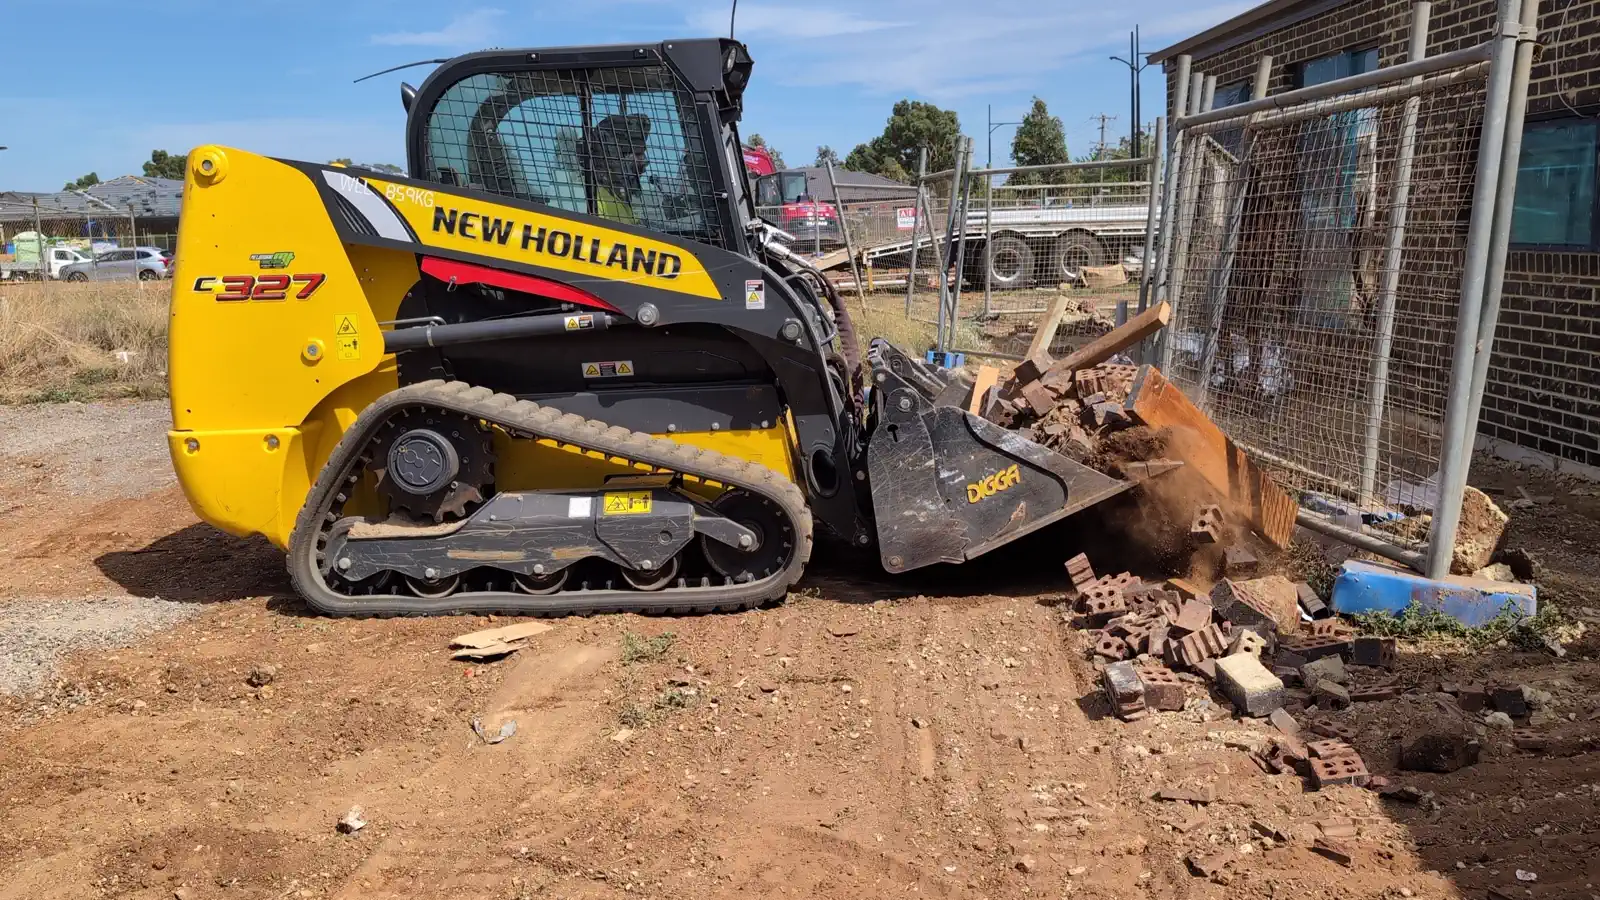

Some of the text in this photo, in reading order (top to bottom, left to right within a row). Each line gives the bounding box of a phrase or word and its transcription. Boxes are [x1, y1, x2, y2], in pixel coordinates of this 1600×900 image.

[386, 183, 435, 208] 859KG
[432, 206, 682, 280] NEW HOLLAND
[967, 464, 1021, 504] DIGGA
